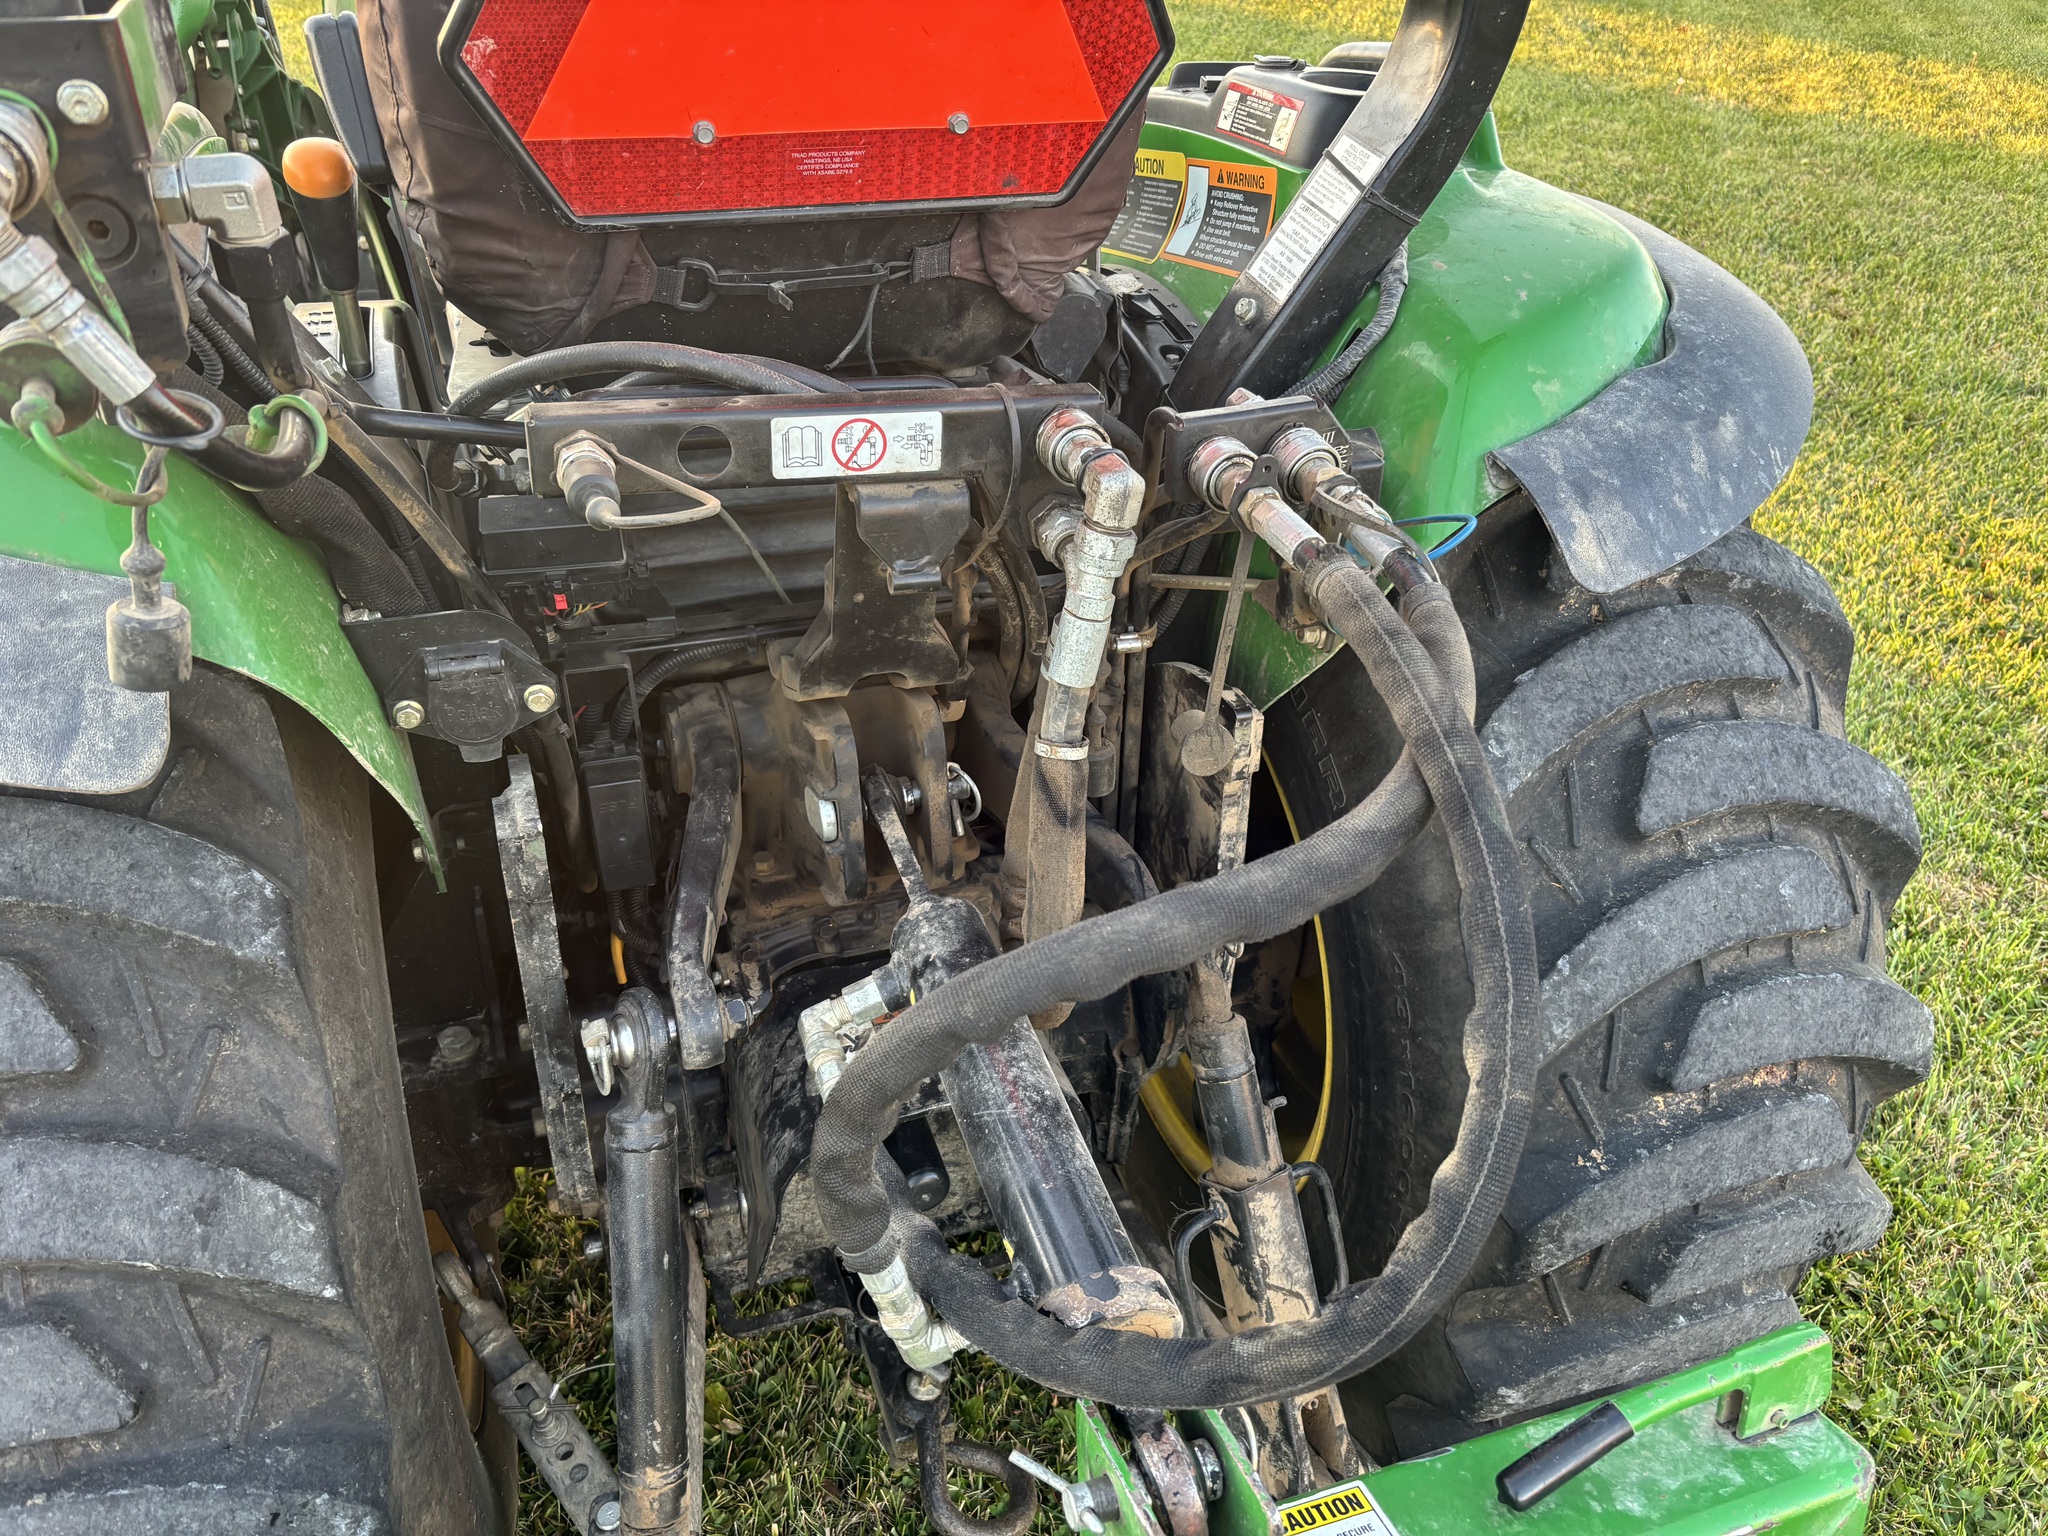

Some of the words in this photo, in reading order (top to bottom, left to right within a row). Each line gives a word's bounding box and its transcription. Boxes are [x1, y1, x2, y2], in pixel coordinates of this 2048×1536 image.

[1135, 157, 1164, 175] AUTION
[1226, 171, 1264, 189] WARNING
[1211, 190, 1223, 198] AVOID
[1224, 191, 1244, 201] CRUSHING:
[1214, 200, 1223, 208] Keep
[1224, 201, 1239, 210] Rollover
[1239, 204, 1258, 213] Protective
[1212, 209, 1229, 218] Structure
[1229, 212, 1237, 220] fully
[1298, 202, 1331, 229] CERTIFICATION
[1214, 227, 1222, 235] seat
[1222, 220, 1232, 228] jump
[1235, 222, 1251, 231] machine
[1205, 243, 1214, 251] NOT
[1210, 236, 1227, 245] structure
[1227, 239, 1237, 247] must
[1237, 241, 1243, 249] be
[1194, 250, 1204, 258] Drive
[1269, 275, 1284, 290] Company
